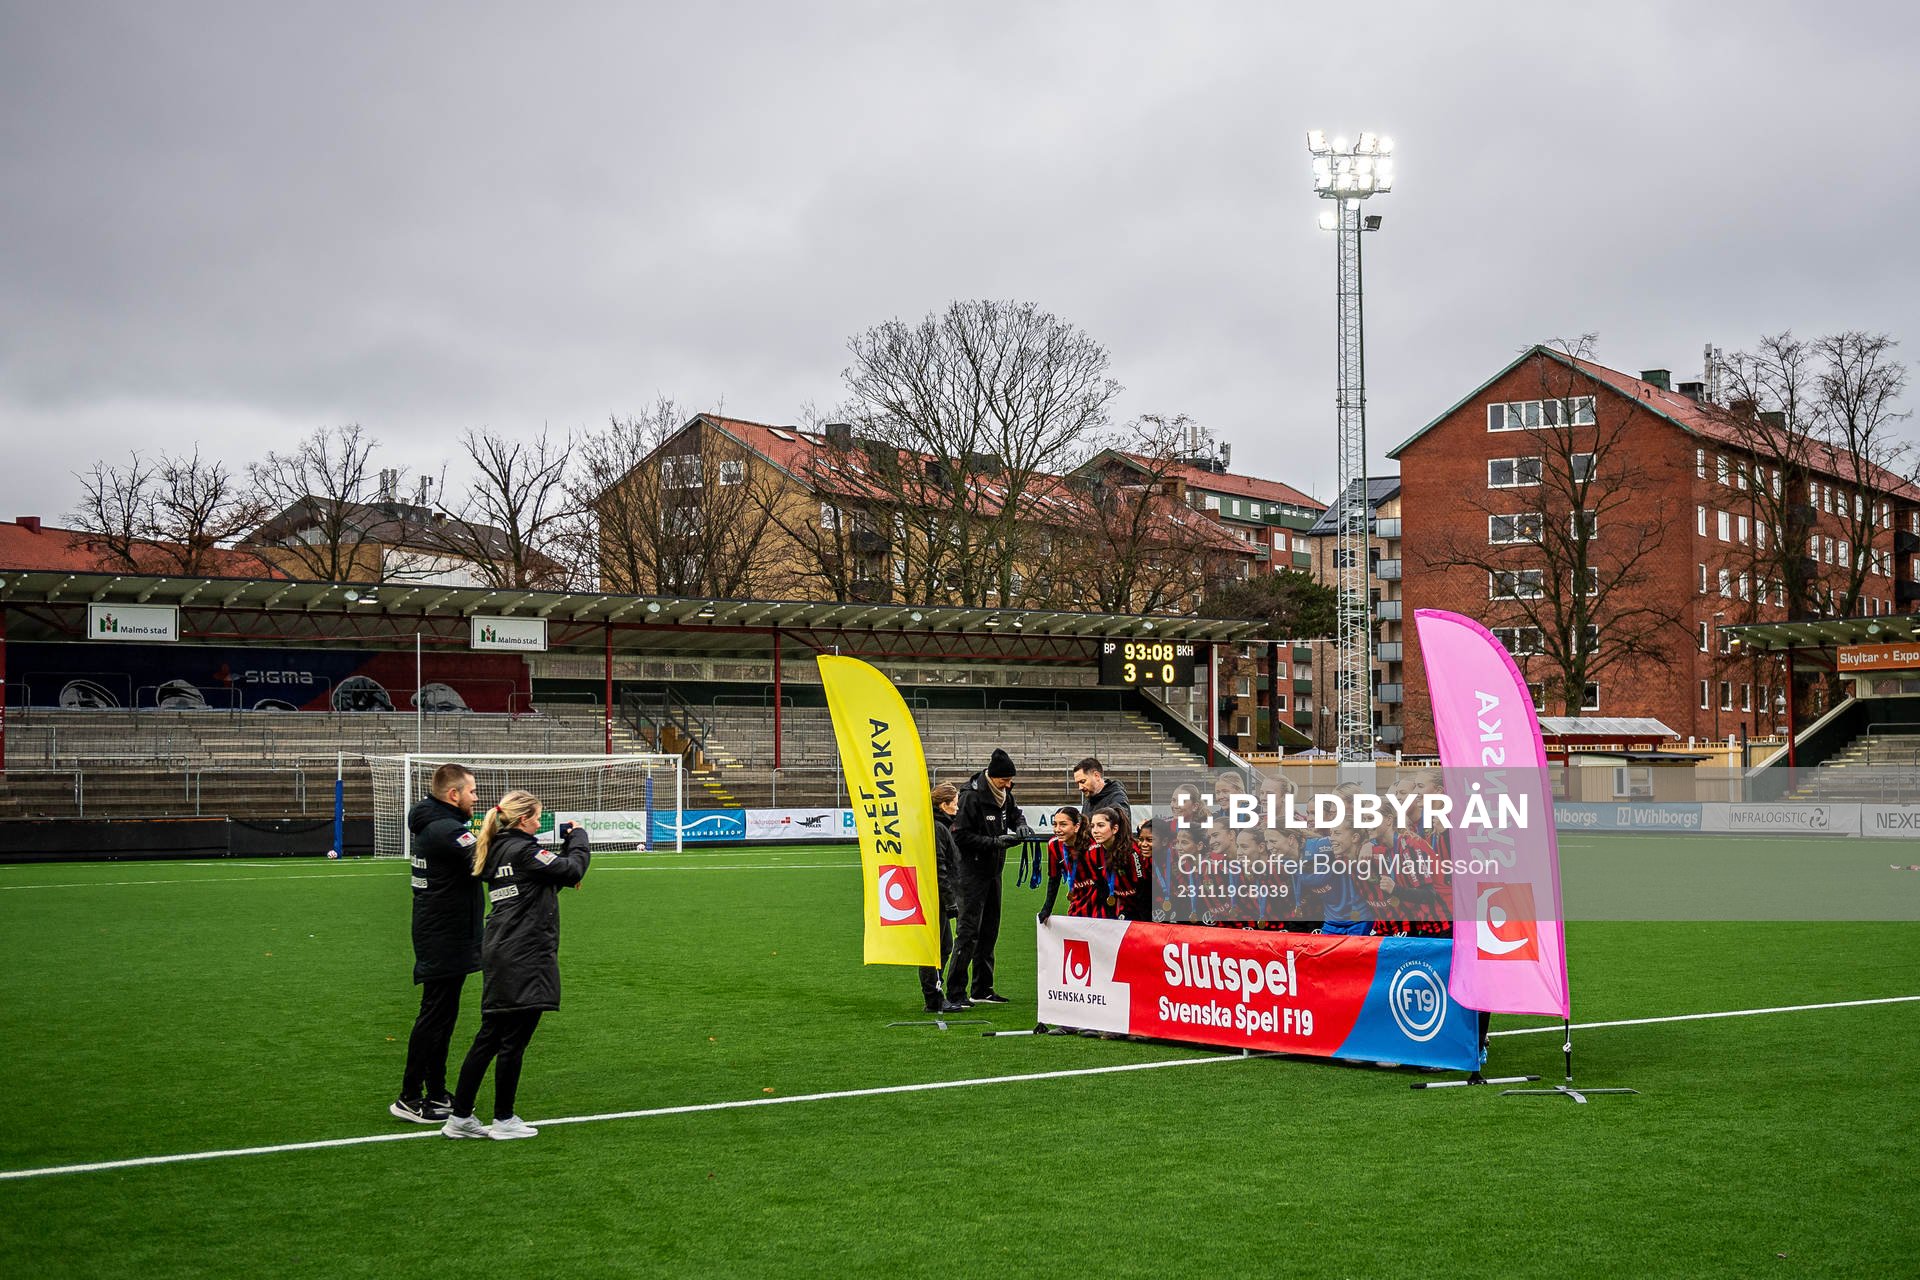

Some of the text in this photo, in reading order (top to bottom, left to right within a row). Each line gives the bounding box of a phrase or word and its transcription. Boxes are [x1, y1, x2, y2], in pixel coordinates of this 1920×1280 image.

[120, 626, 168, 634] Malmö stad
[498, 636, 538, 645] Malmö stad
[1104, 643, 1194, 661] BP 93:08 BKH
[1840, 652, 1879, 666] Skyltar
[1123, 663, 1136, 682] 3
[1162, 664, 1174, 683] 0
[1554, 808, 1598, 826] hlborgs
[1634, 809, 1698, 827] Wihlborgs
[1731, 811, 1807, 823] INFRALOGISTIC
[1162, 943, 1298, 1003] Slutspel
[1048, 989, 1107, 1006] SVENSKA SPEL
[1403, 988, 1435, 1012] F19
[1159, 995, 1313, 1036] Svenska Spel F19
